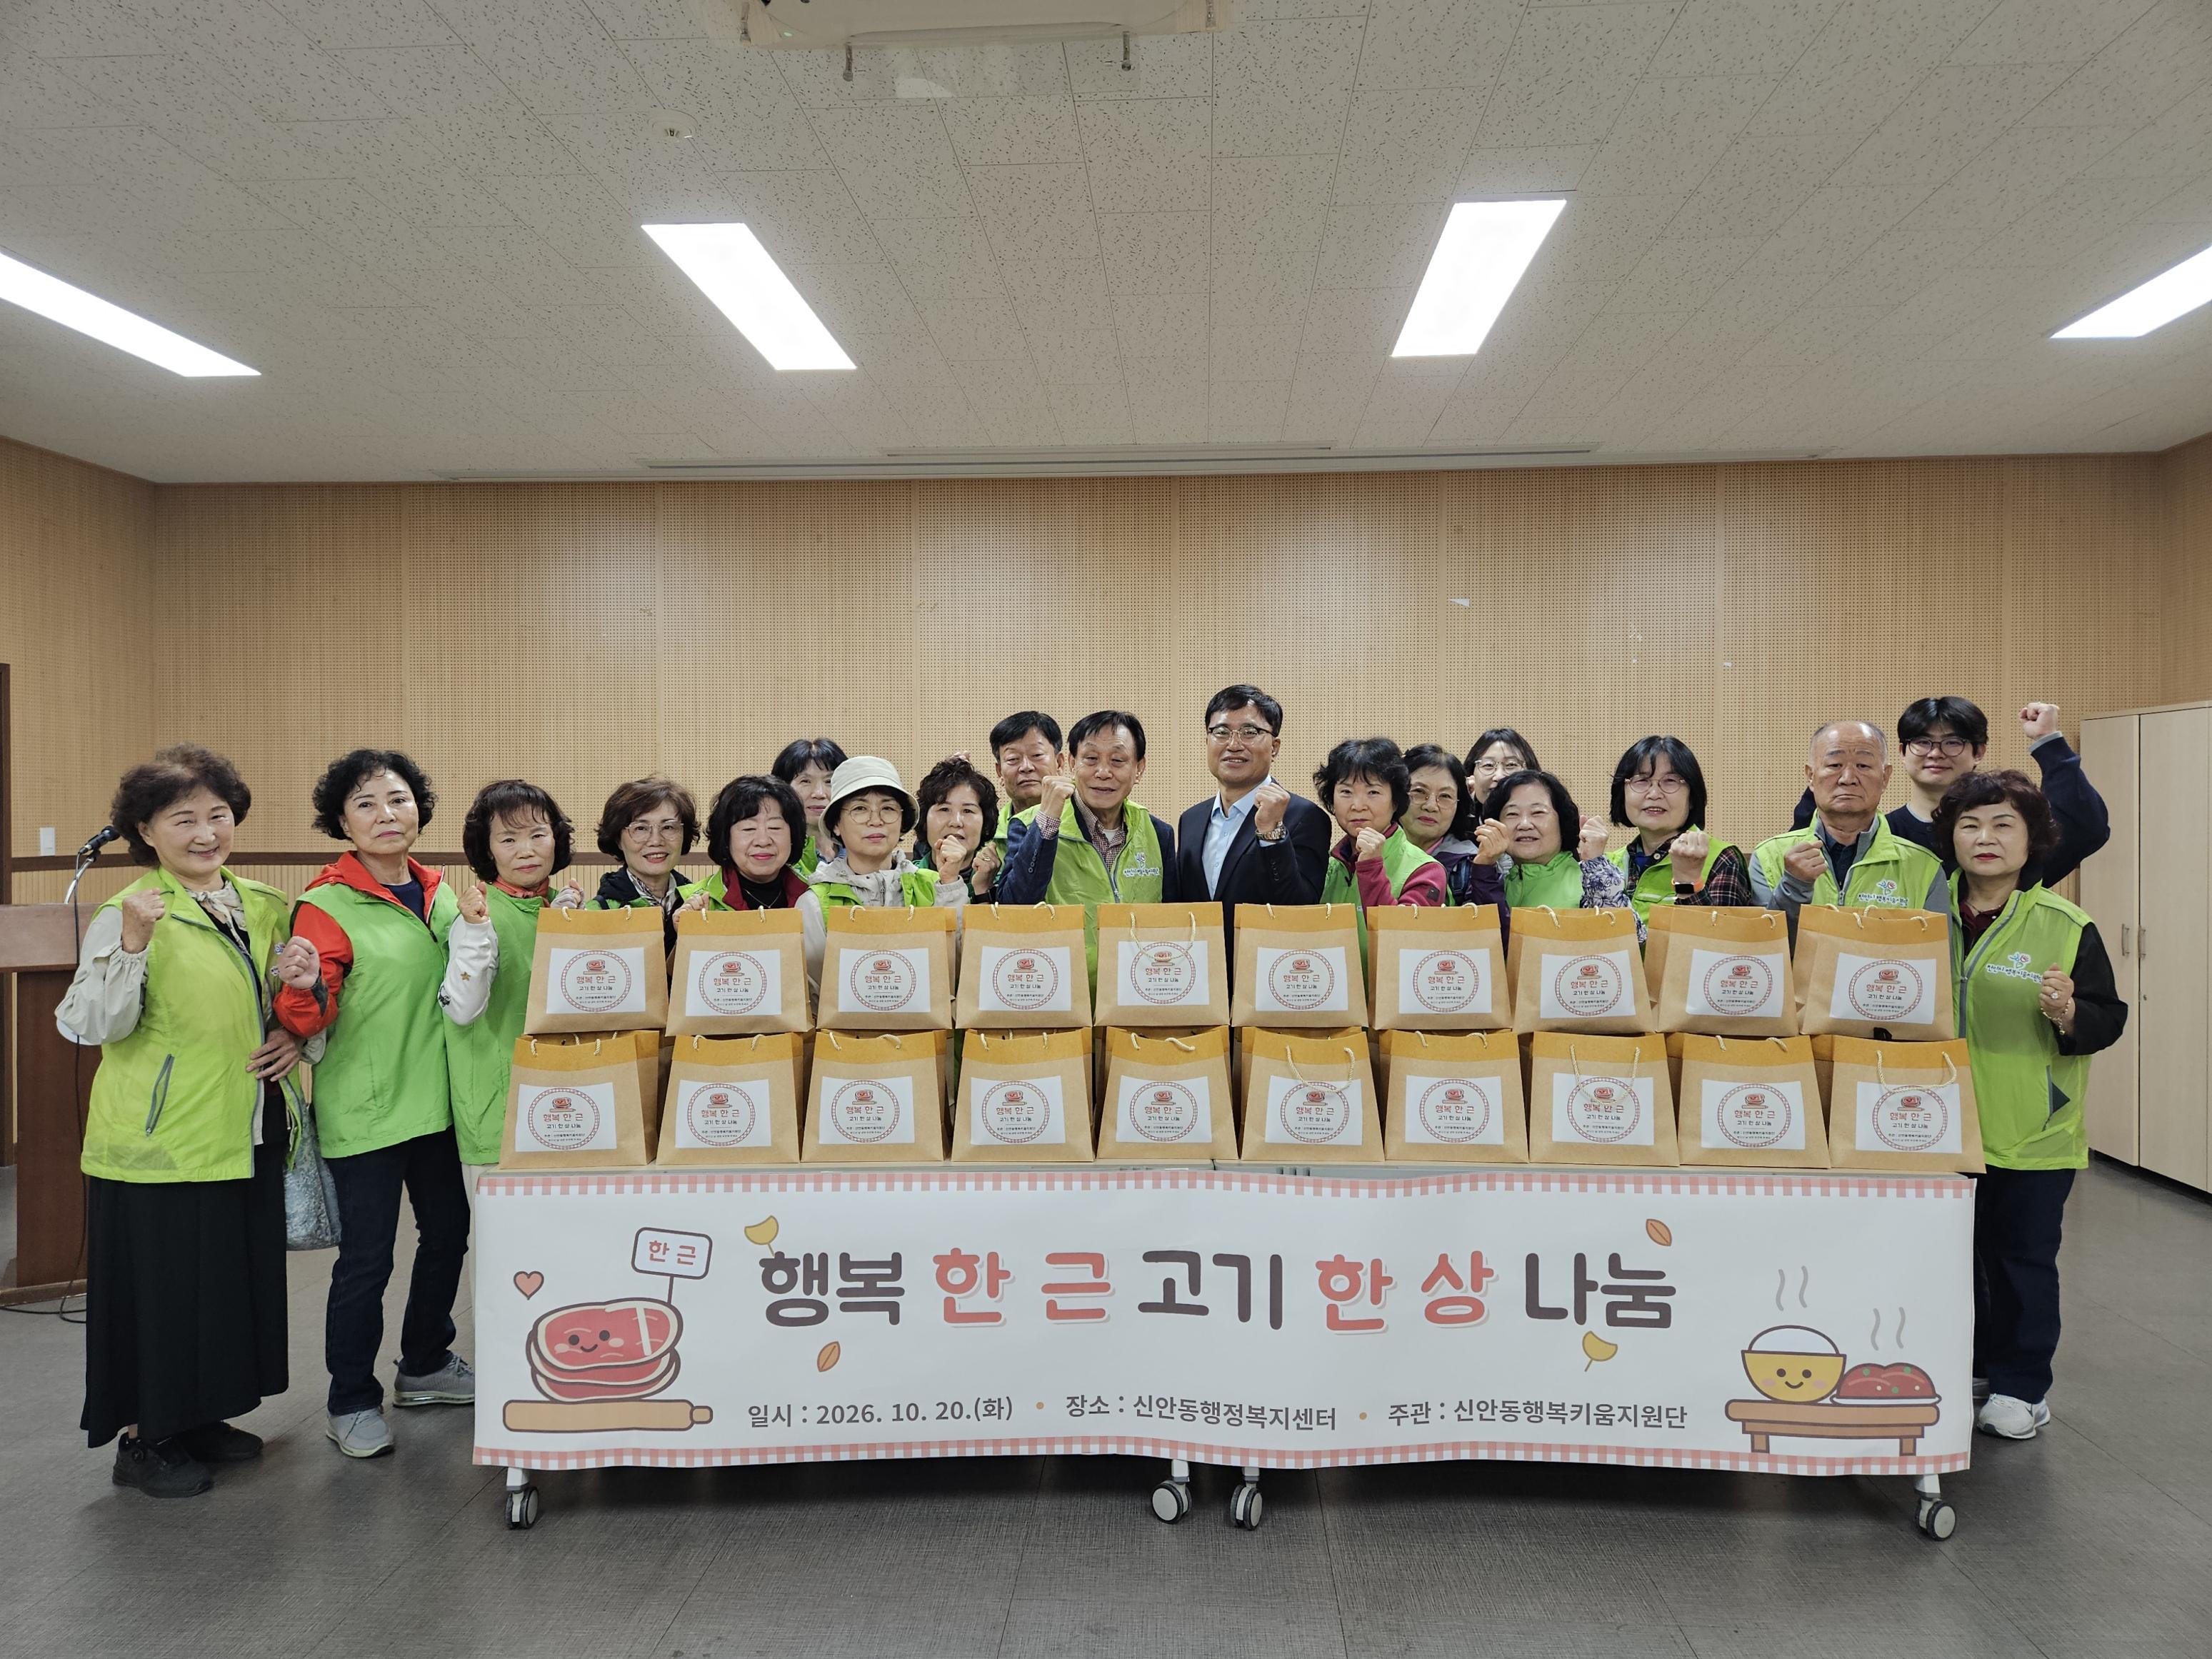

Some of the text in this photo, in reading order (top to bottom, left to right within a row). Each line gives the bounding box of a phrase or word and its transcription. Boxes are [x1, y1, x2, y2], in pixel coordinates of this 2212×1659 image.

[1145, 967, 1161, 976] 행복
[596, 976, 605, 984] 한
[714, 978, 729, 986] 행복
[1301, 974, 1310, 983] 한
[1446, 976, 1454, 984] 한
[1571, 981, 1586, 989] 행복
[1866, 984, 1883, 993] 행복
[1886, 985, 1895, 993] 한
[846, 1106, 861, 1115] 행복
[865, 1106, 874, 1114] 한
[1315, 1107, 1323, 1116] 한
[1435, 1105, 1451, 1113] 행복
[1455, 1105, 1463, 1114] 한
[1583, 1103, 1601, 1112] 행복
[543, 1113, 560, 1122] 행복
[563, 1113, 571, 1122] 한
[720, 1109, 729, 1118] 한
[1734, 1110, 1751, 1118] 행복
[1755, 1110, 1763, 1118] 한
[1890, 1112, 1907, 1121] 행복
[1911, 1113, 1920, 1121] 한
[649, 1240, 696, 1265] 한 근
[759, 1248, 1676, 1330] 행복 한 근 고기 한 상 나눔
[749, 1397, 1012, 1428] 일시 : 2026. 10. 20.(화)
[1066, 1395, 1336, 1430] 장소 : 신안동행정복지센터
[1388, 1399, 1687, 1429] 주관 : 신안동행복키움지원단
